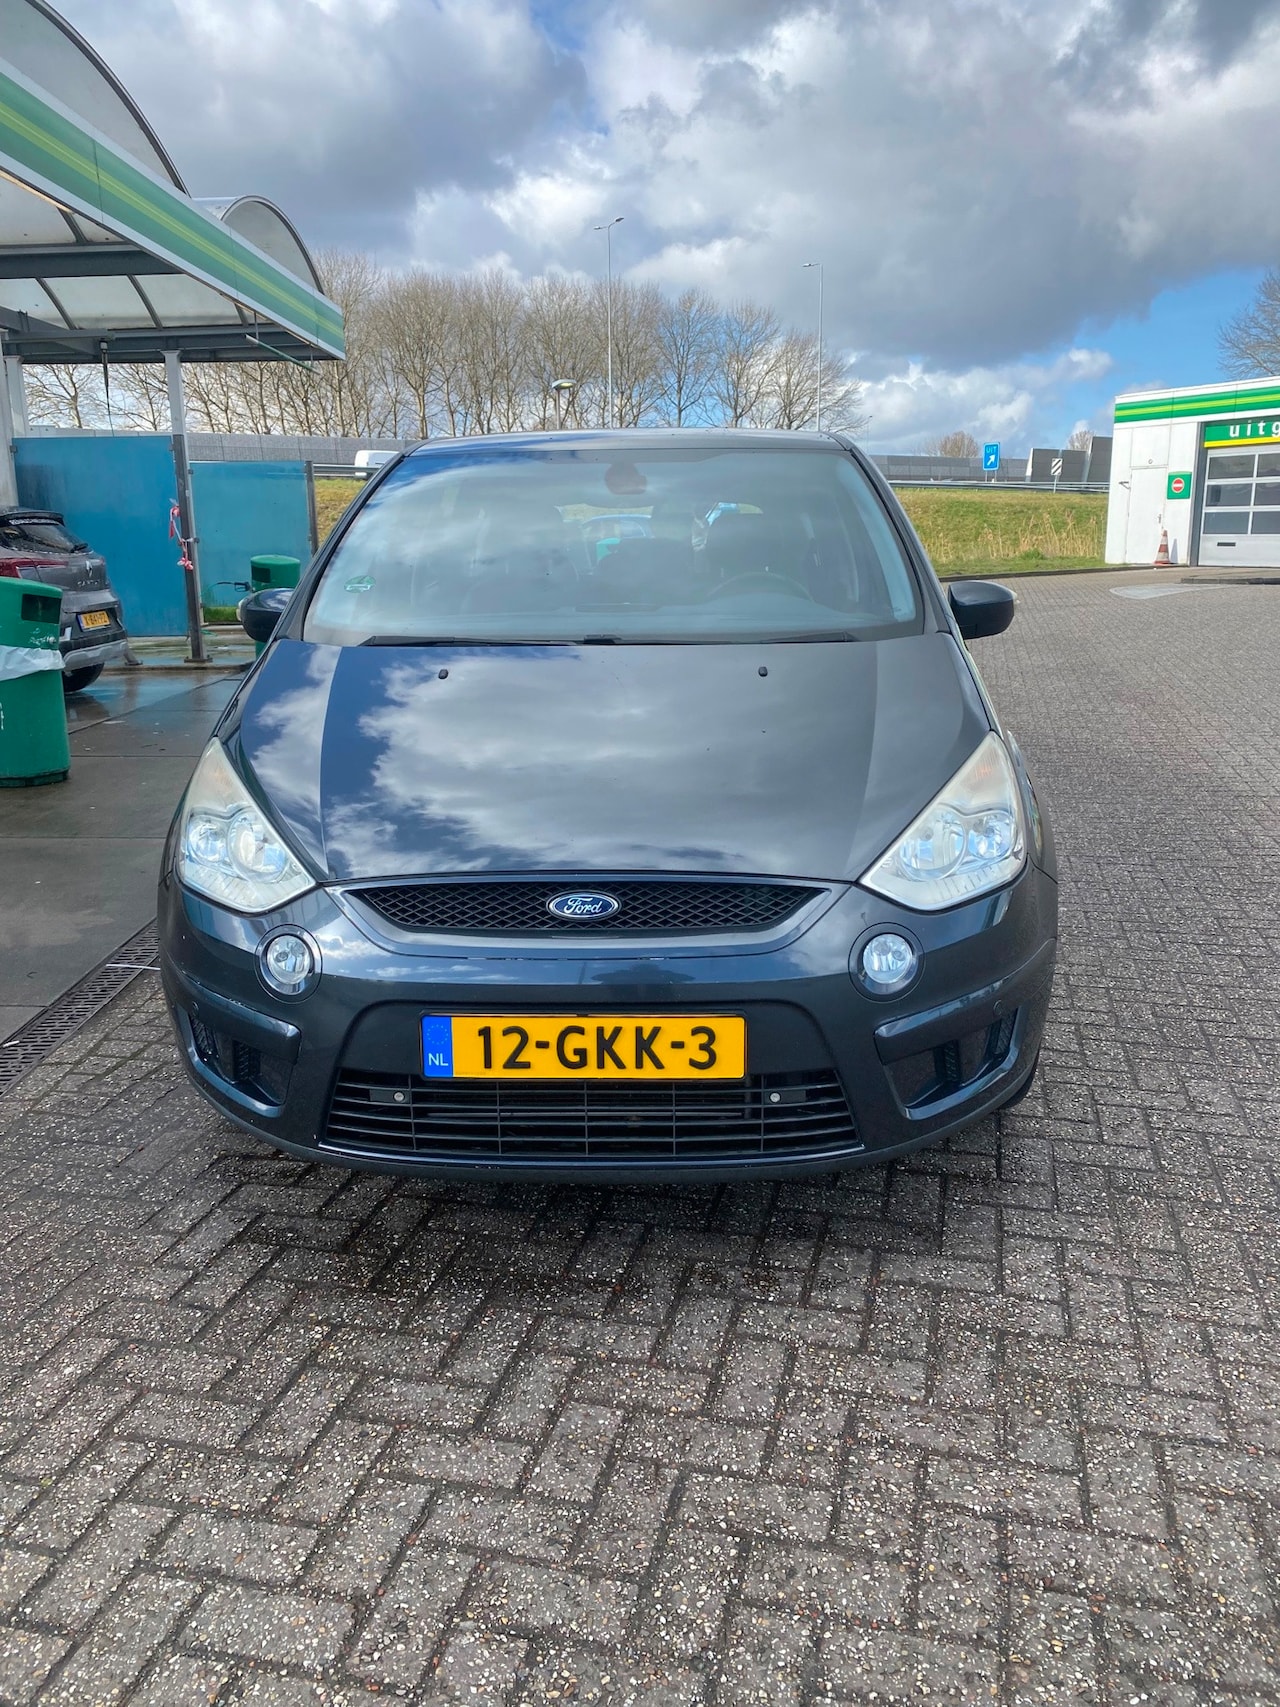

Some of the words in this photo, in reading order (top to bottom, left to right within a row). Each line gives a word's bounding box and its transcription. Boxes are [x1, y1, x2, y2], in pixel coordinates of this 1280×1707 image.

[563, 897, 603, 914] Ford
[478, 1025, 717, 1070] 12-GKK-3
[428, 1052, 449, 1066] NL
